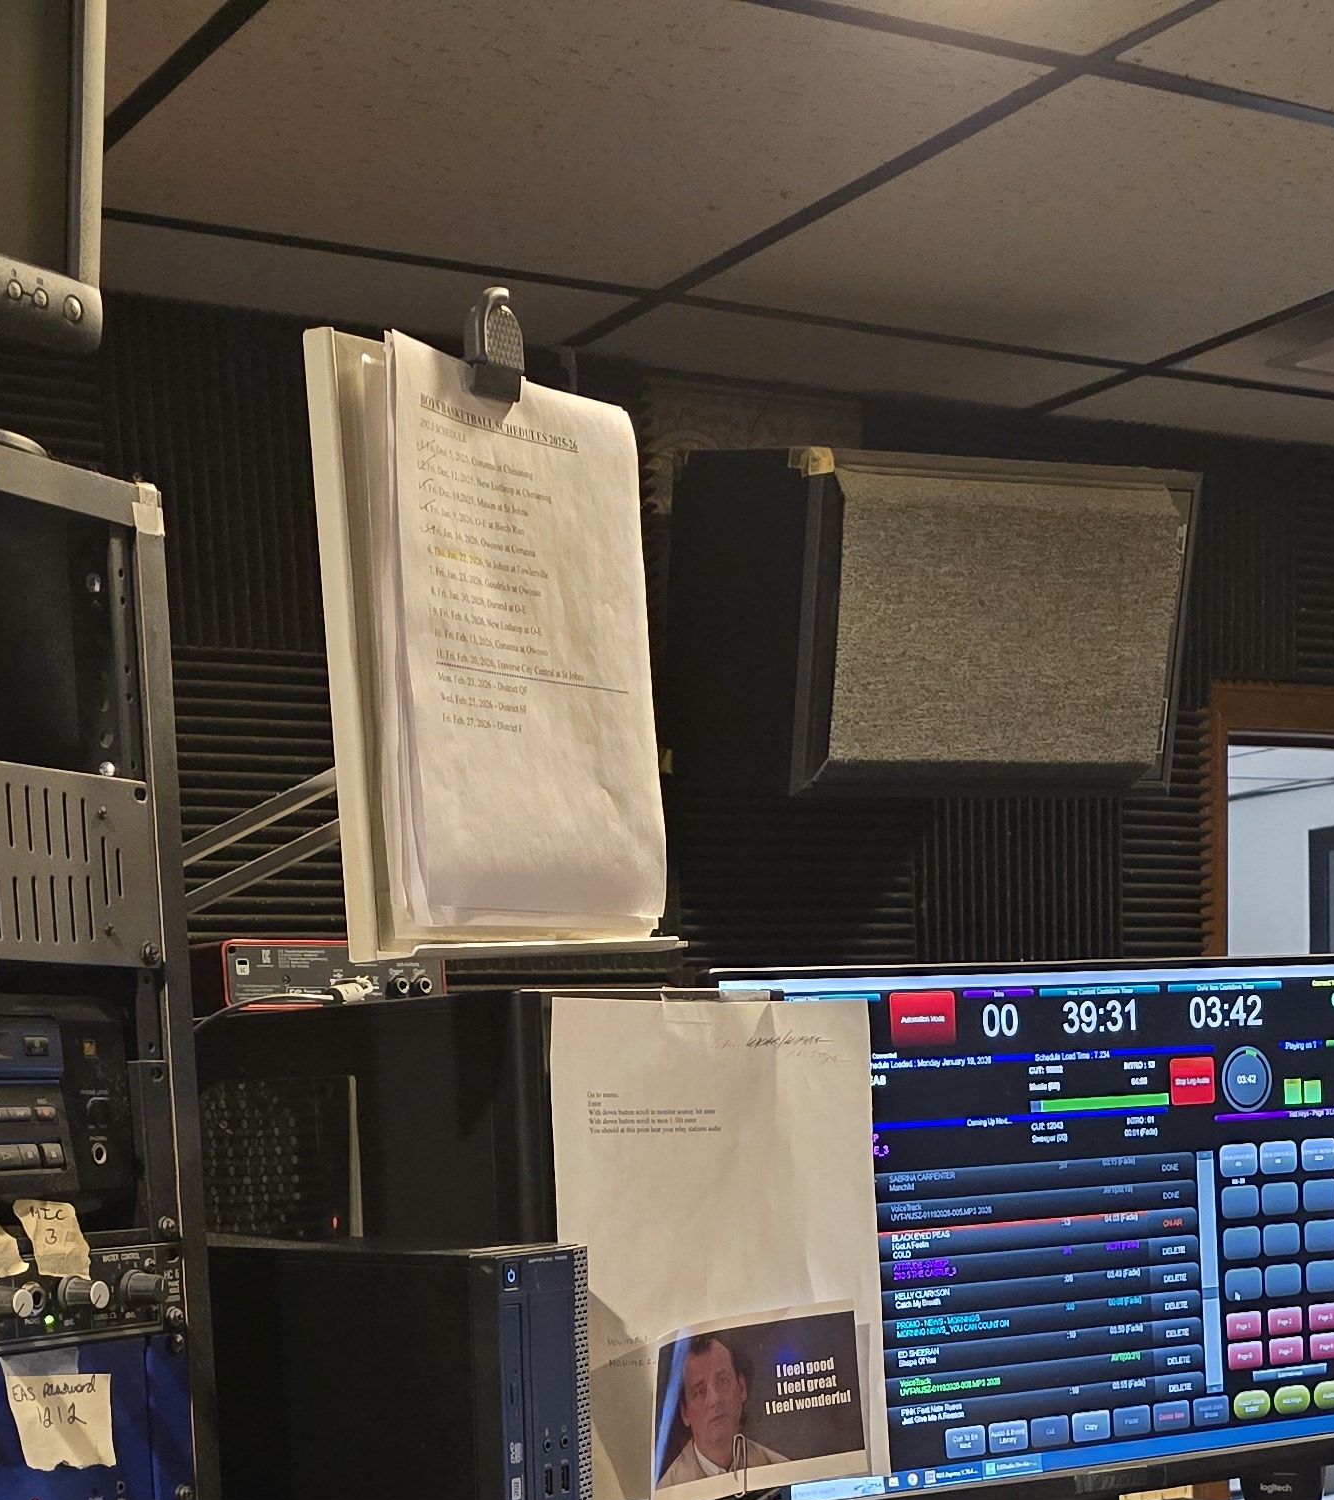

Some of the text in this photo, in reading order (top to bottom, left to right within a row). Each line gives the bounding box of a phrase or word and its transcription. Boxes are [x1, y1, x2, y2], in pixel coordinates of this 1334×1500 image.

[421, 393, 578, 450] BOYS BASKETBALL SCHEDULES 2025-26
[1062, 999, 1139, 1034] 39:31
[1189, 994, 1263, 1029] 03:42
[982, 1003, 1018, 1038] 00
[1162, 1162, 1179, 1173] DONE
[889, 1171, 955, 1183] SABRINA CARPENTER
[1163, 1190, 1180, 1200] DONE
[30, 1206, 66, 1222] MIC
[45, 1228, 57, 1245] 3
[1162, 1245, 1185, 1255] DELETE
[1164, 1272, 1187, 1283] DELETE
[1165, 1301, 1188, 1310] DELETE
[1166, 1327, 1189, 1337] DELETE
[776, 1357, 834, 1377] I feel good
[1167, 1355, 1191, 1365] DELETE
[777, 1375, 837, 1395] I feel great
[1169, 1382, 1192, 1392] DELETE
[12, 1385, 36, 1403] EAS
[766, 1390, 851, 1415] I feel wonderful
[37, 1403, 87, 1428] 1212
